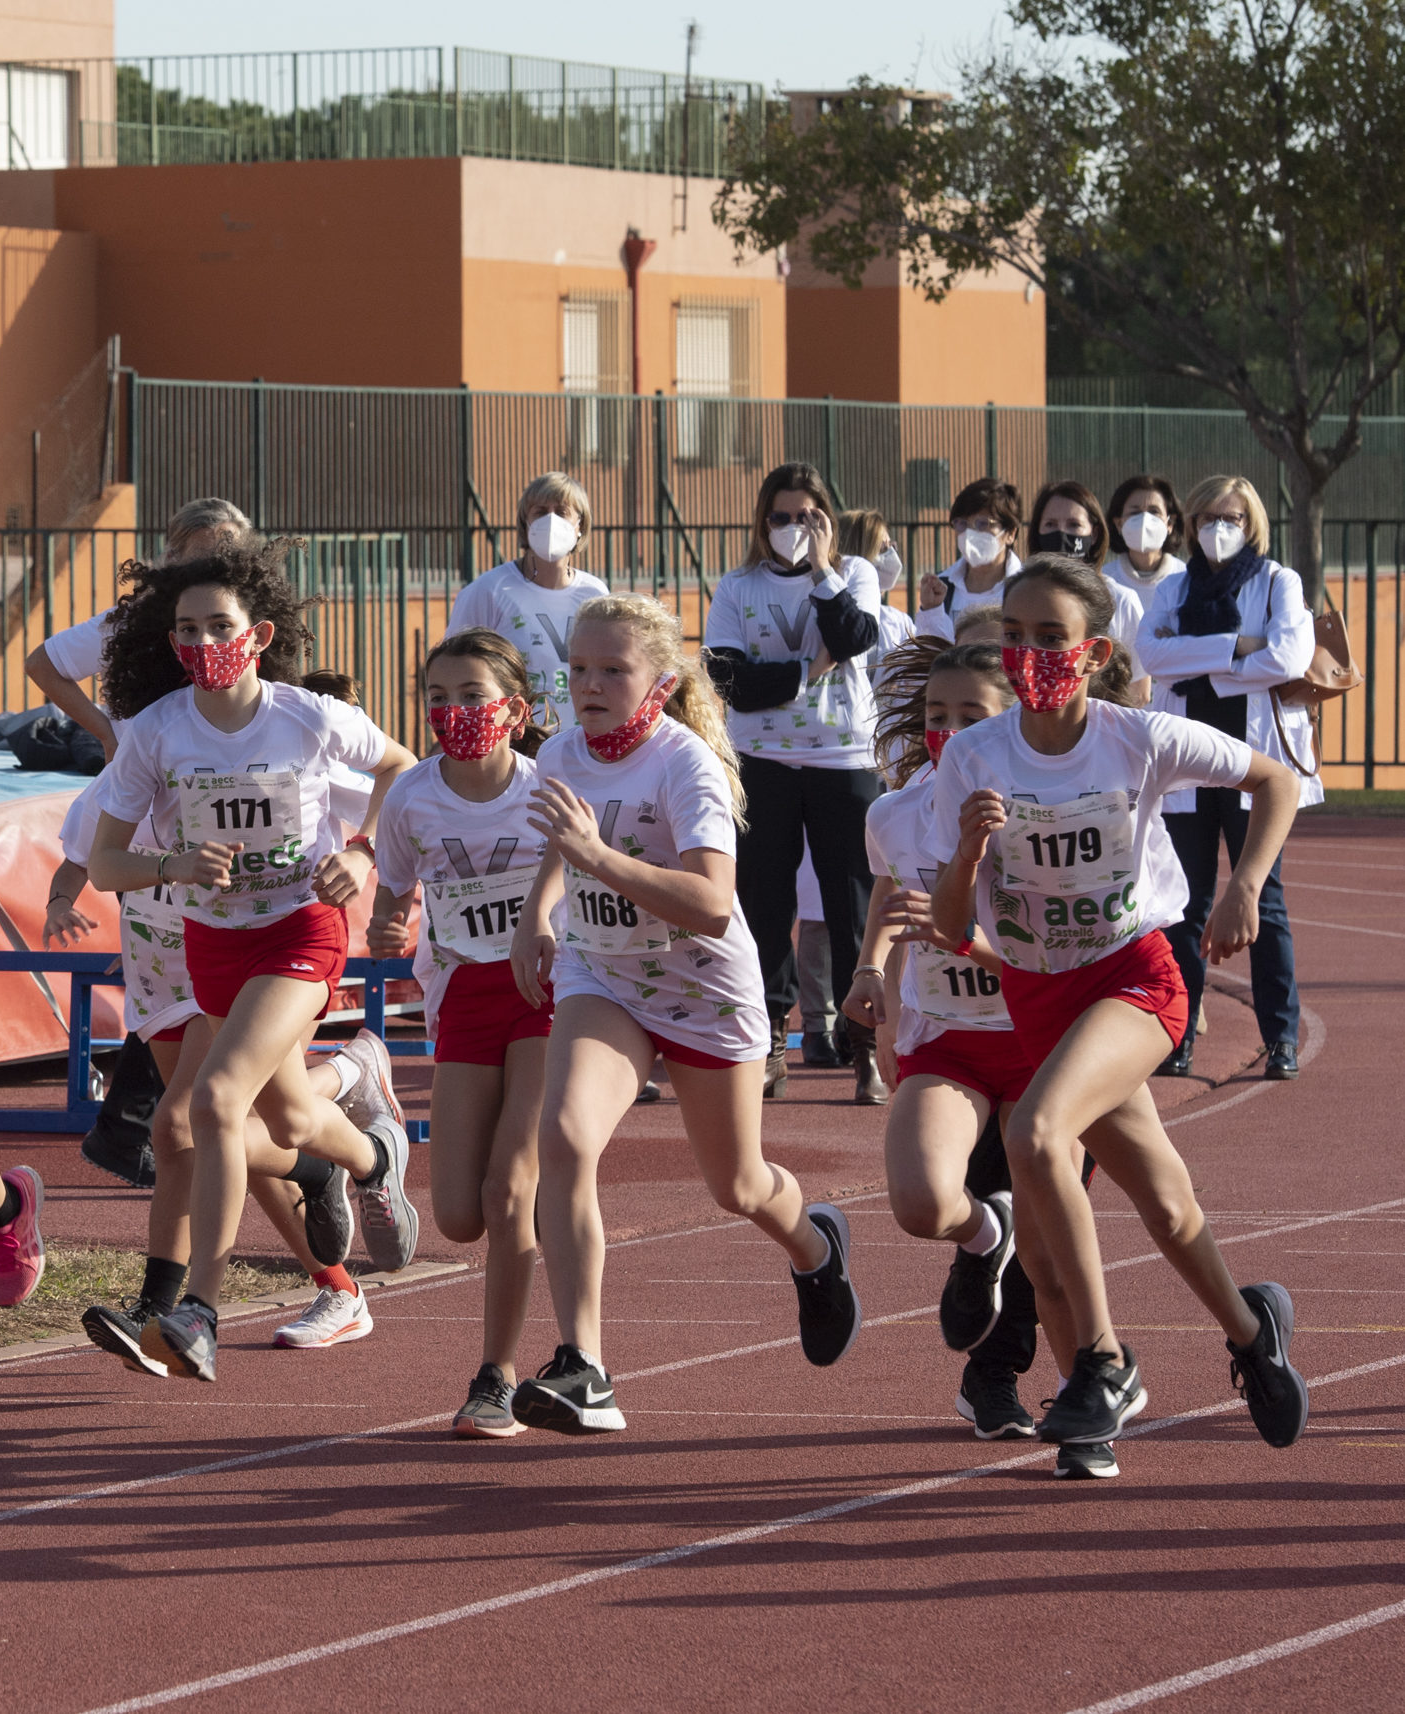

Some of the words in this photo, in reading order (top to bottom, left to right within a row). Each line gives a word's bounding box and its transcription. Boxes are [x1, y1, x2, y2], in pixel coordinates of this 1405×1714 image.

[211, 776, 234, 784] aecc
[210, 798, 272, 829] 1171
[1030, 807, 1054, 818] aecc
[1026, 827, 1102, 868] 1179
[460, 881, 484, 891] aecc
[460, 896, 524, 938] 1175
[577, 889, 639, 928] 1168
[1045, 881, 1137, 926] aecc
[1044, 937, 1073, 950] en
[1048, 926, 1095, 938] Castelló
[942, 966, 1001, 997] 116
